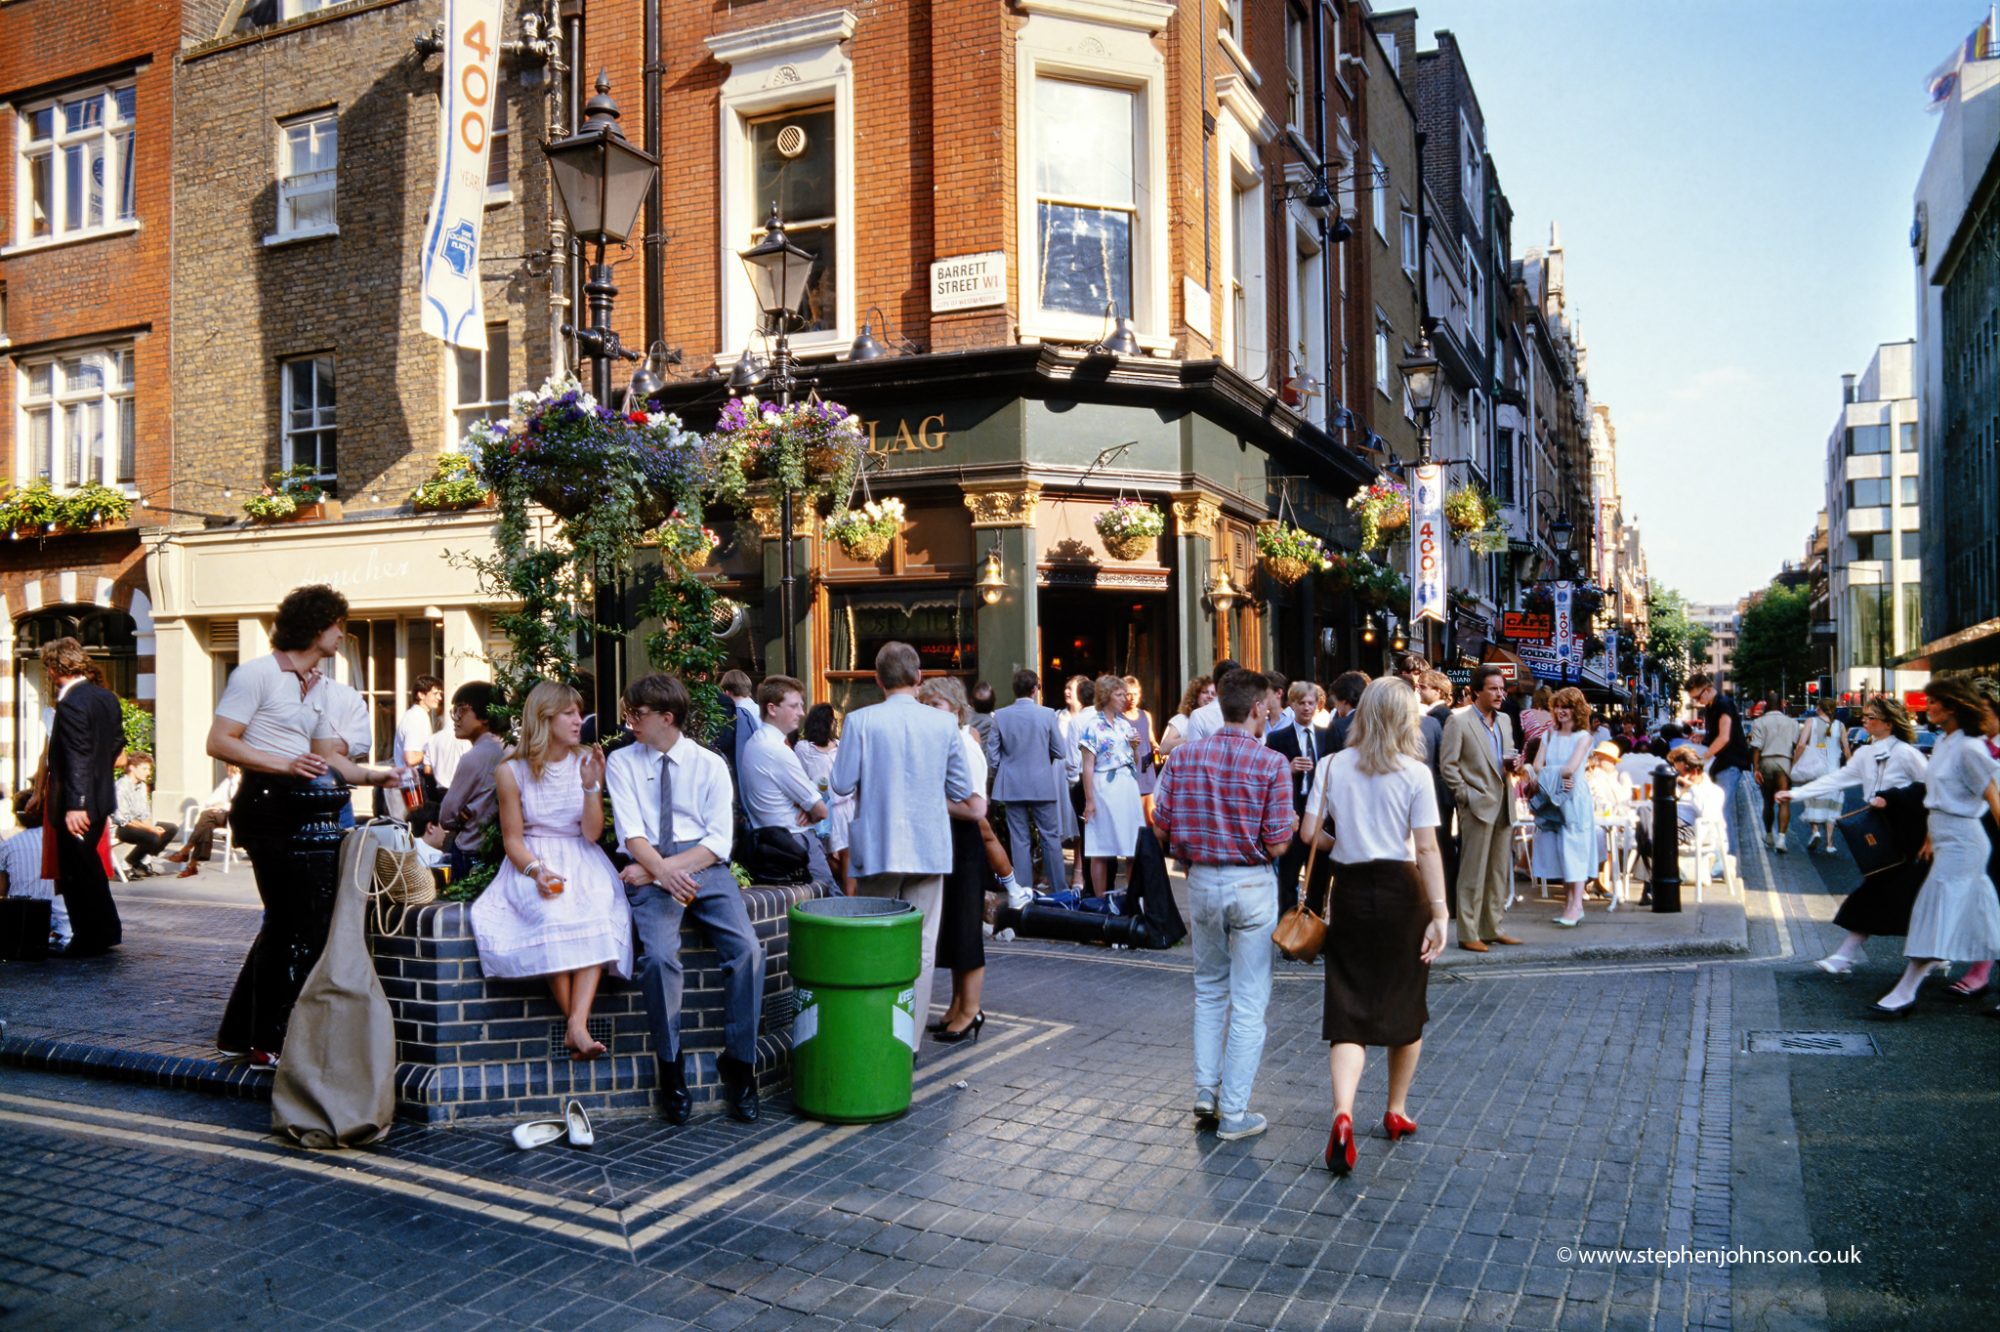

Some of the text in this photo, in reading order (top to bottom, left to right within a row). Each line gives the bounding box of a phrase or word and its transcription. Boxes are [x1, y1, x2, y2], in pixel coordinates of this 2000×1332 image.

[461, 20, 492, 153] 400
[938, 262, 987, 279] BARRETT
[938, 275, 998, 294] STREET W1
[864, 413, 950, 458] LAG
[1419, 522, 1436, 571] 400
[1559, 612, 1569, 638] 400
